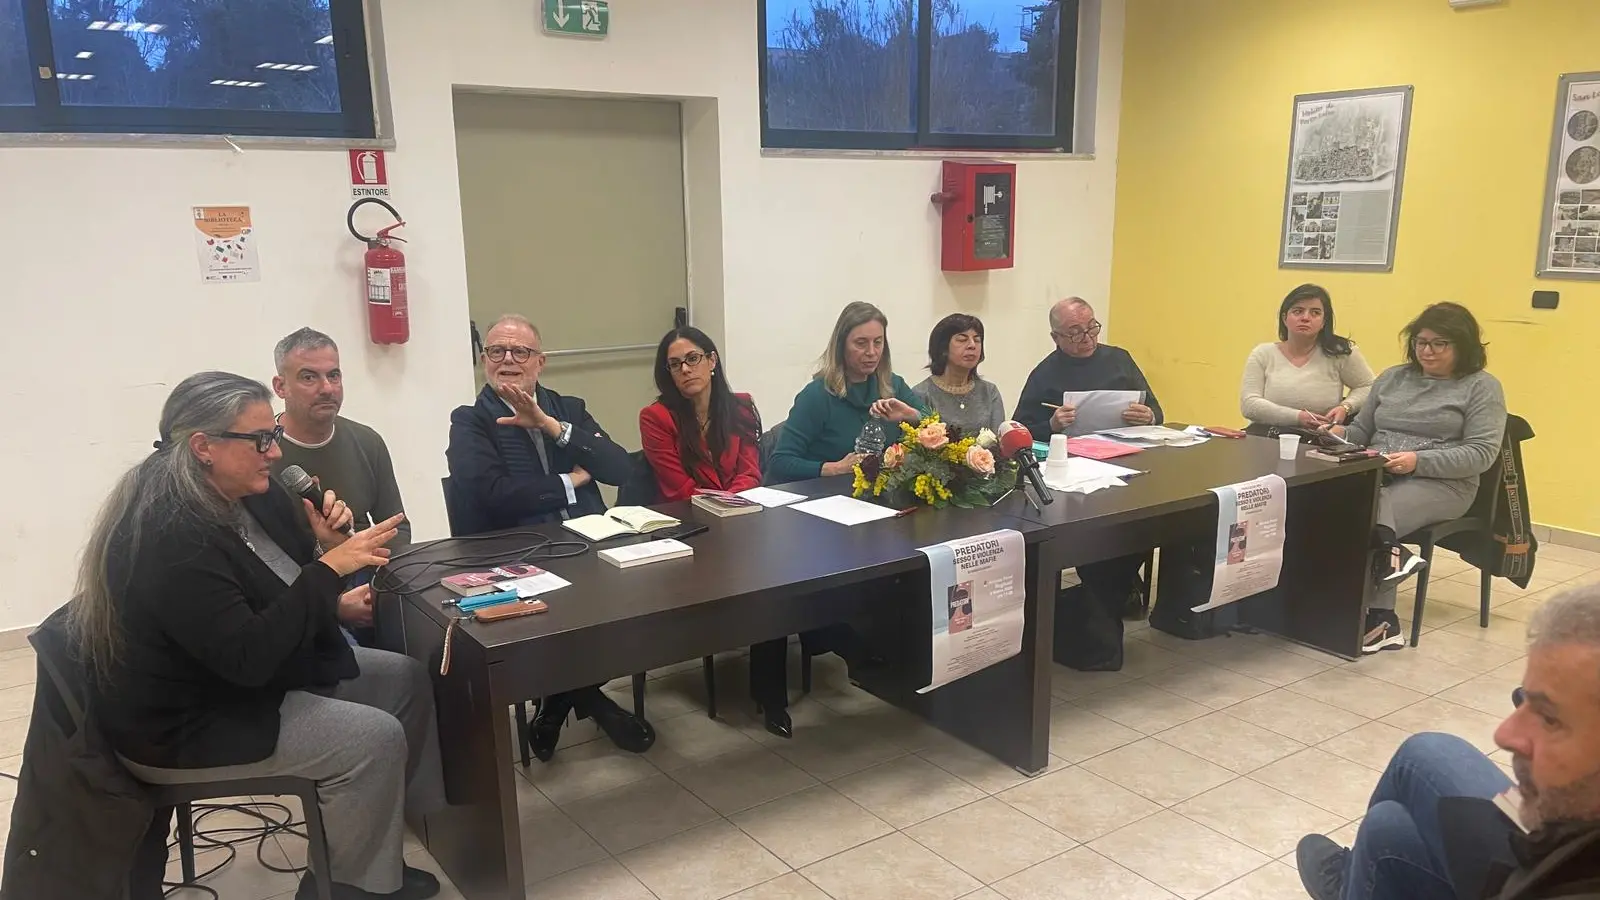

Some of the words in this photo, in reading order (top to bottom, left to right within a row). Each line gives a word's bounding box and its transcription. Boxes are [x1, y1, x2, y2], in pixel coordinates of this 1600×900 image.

[353, 188, 389, 196] ESTINTORE
[1237, 488, 1270, 499] PREDATORI
[955, 539, 1000, 557] PREDATORI
[952, 555, 972, 565] SESSO
[977, 547, 1004, 559] VIOLENZA
[960, 560, 979, 570] NELLE
[979, 555, 997, 565] MAFIE
